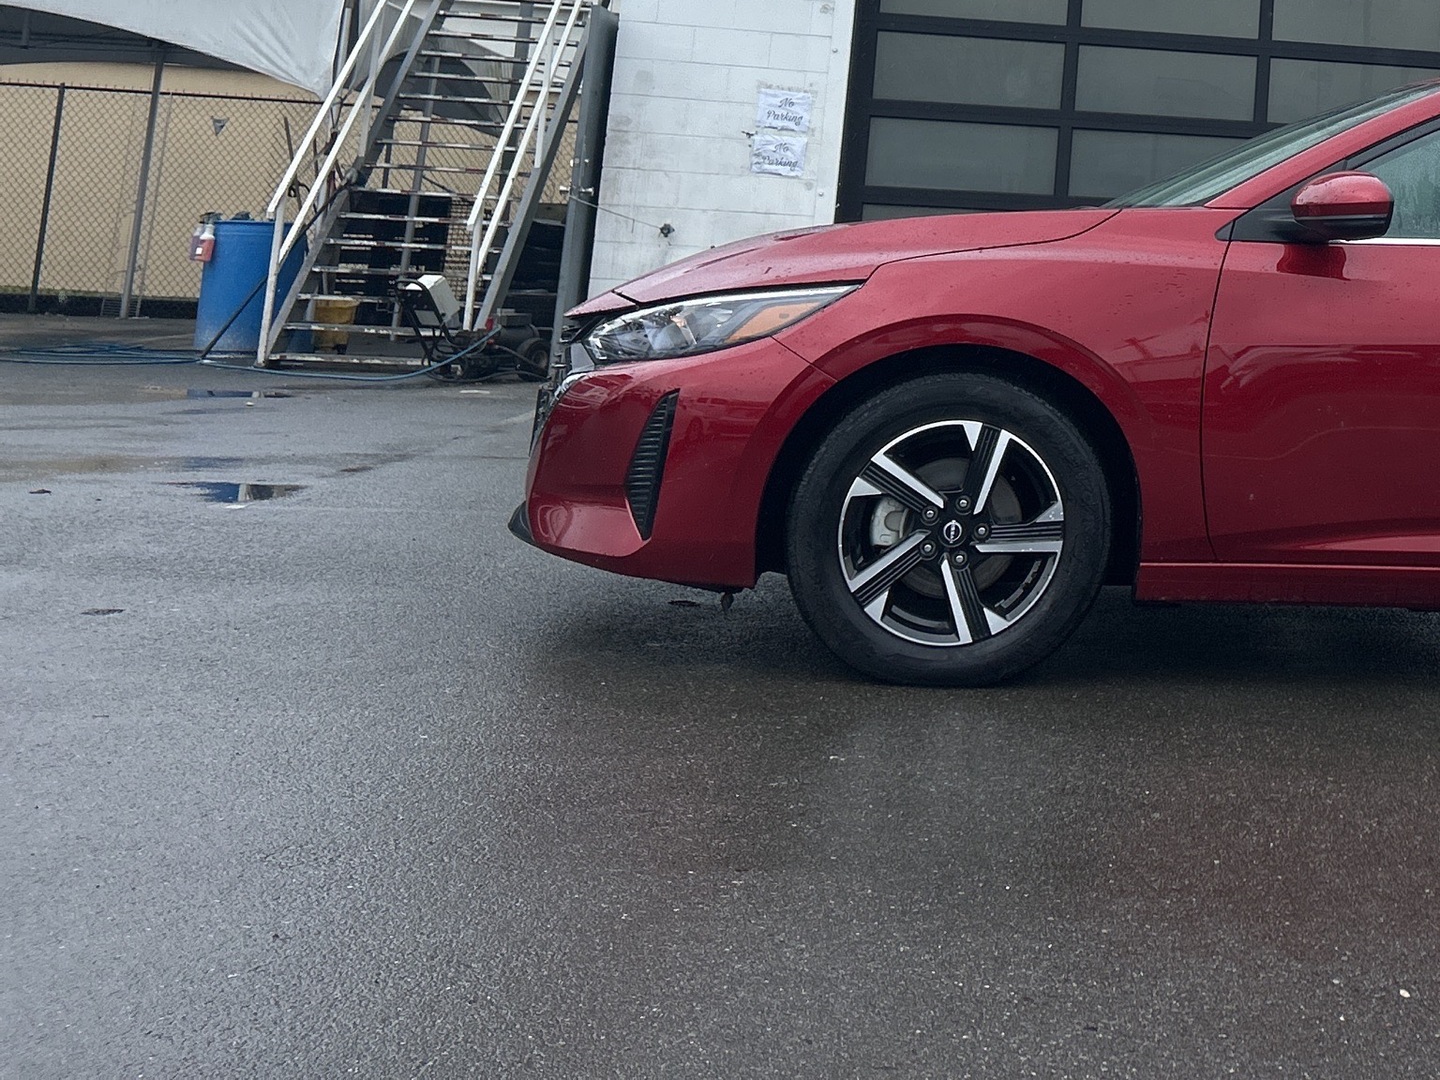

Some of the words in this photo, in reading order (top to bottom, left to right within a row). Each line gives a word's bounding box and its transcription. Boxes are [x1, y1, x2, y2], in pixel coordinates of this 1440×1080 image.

[779, 97, 795, 108] No
[766, 110, 803, 126] Parking
[774, 142, 790, 153] No
[763, 155, 798, 171] Parking
